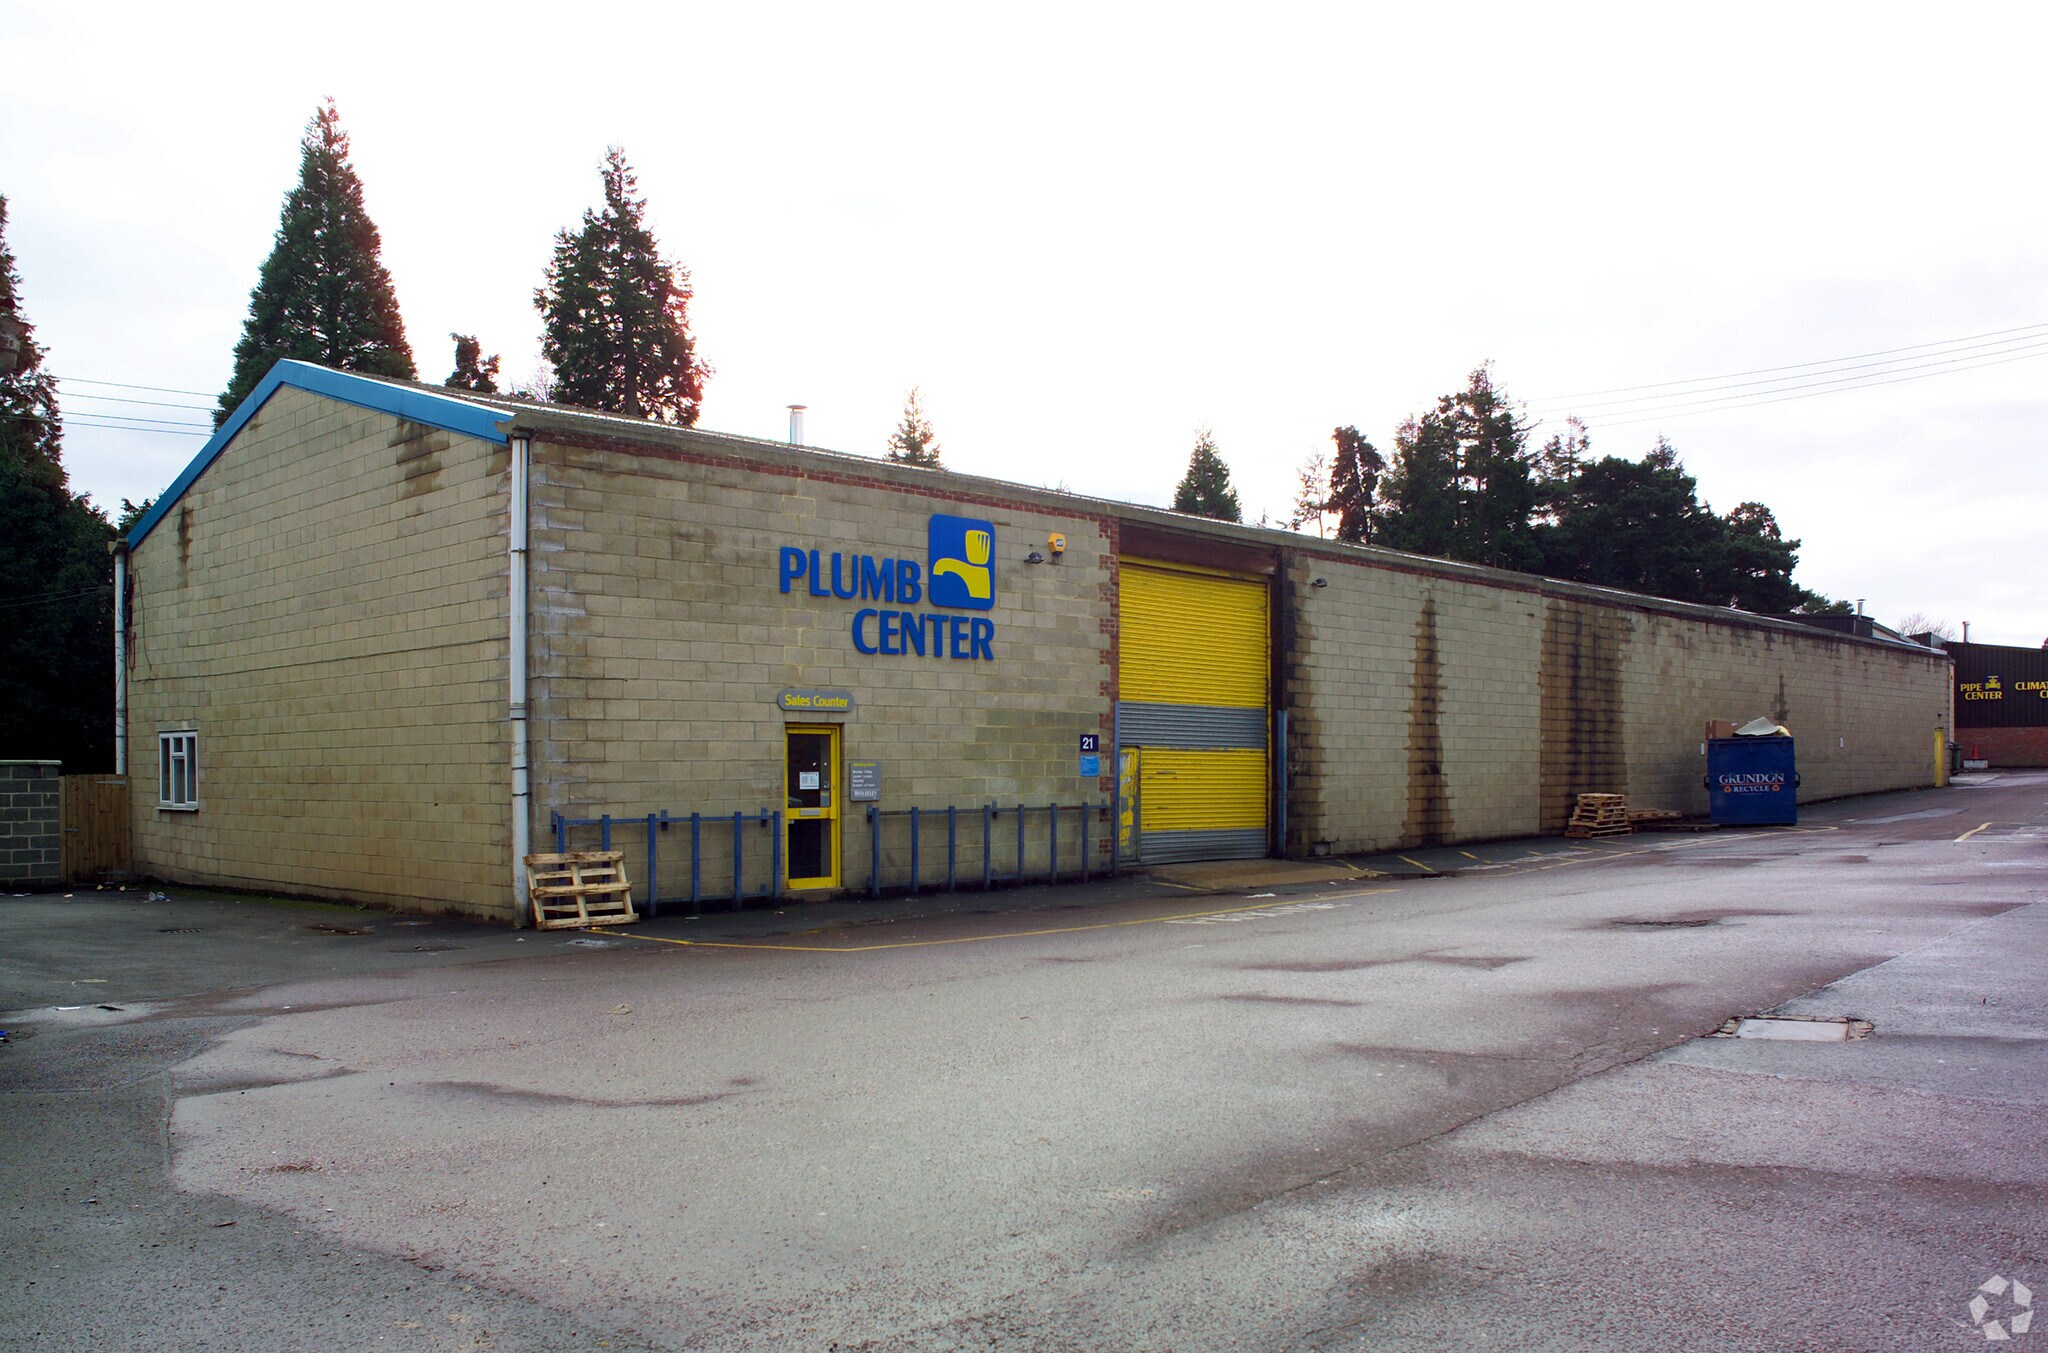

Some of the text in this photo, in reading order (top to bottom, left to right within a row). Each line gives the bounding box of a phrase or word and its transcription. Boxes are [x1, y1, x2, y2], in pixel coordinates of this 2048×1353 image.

[780, 547, 922, 605] PLUMB
[852, 608, 995, 660] CENTER
[1960, 683, 1982, 692] PIPE
[785, 694, 848, 708] Sales Counter
[1965, 691, 2003, 700] CENTER
[1082, 737, 1093, 749] 21
[1719, 774, 1784, 784] GRUNDON
